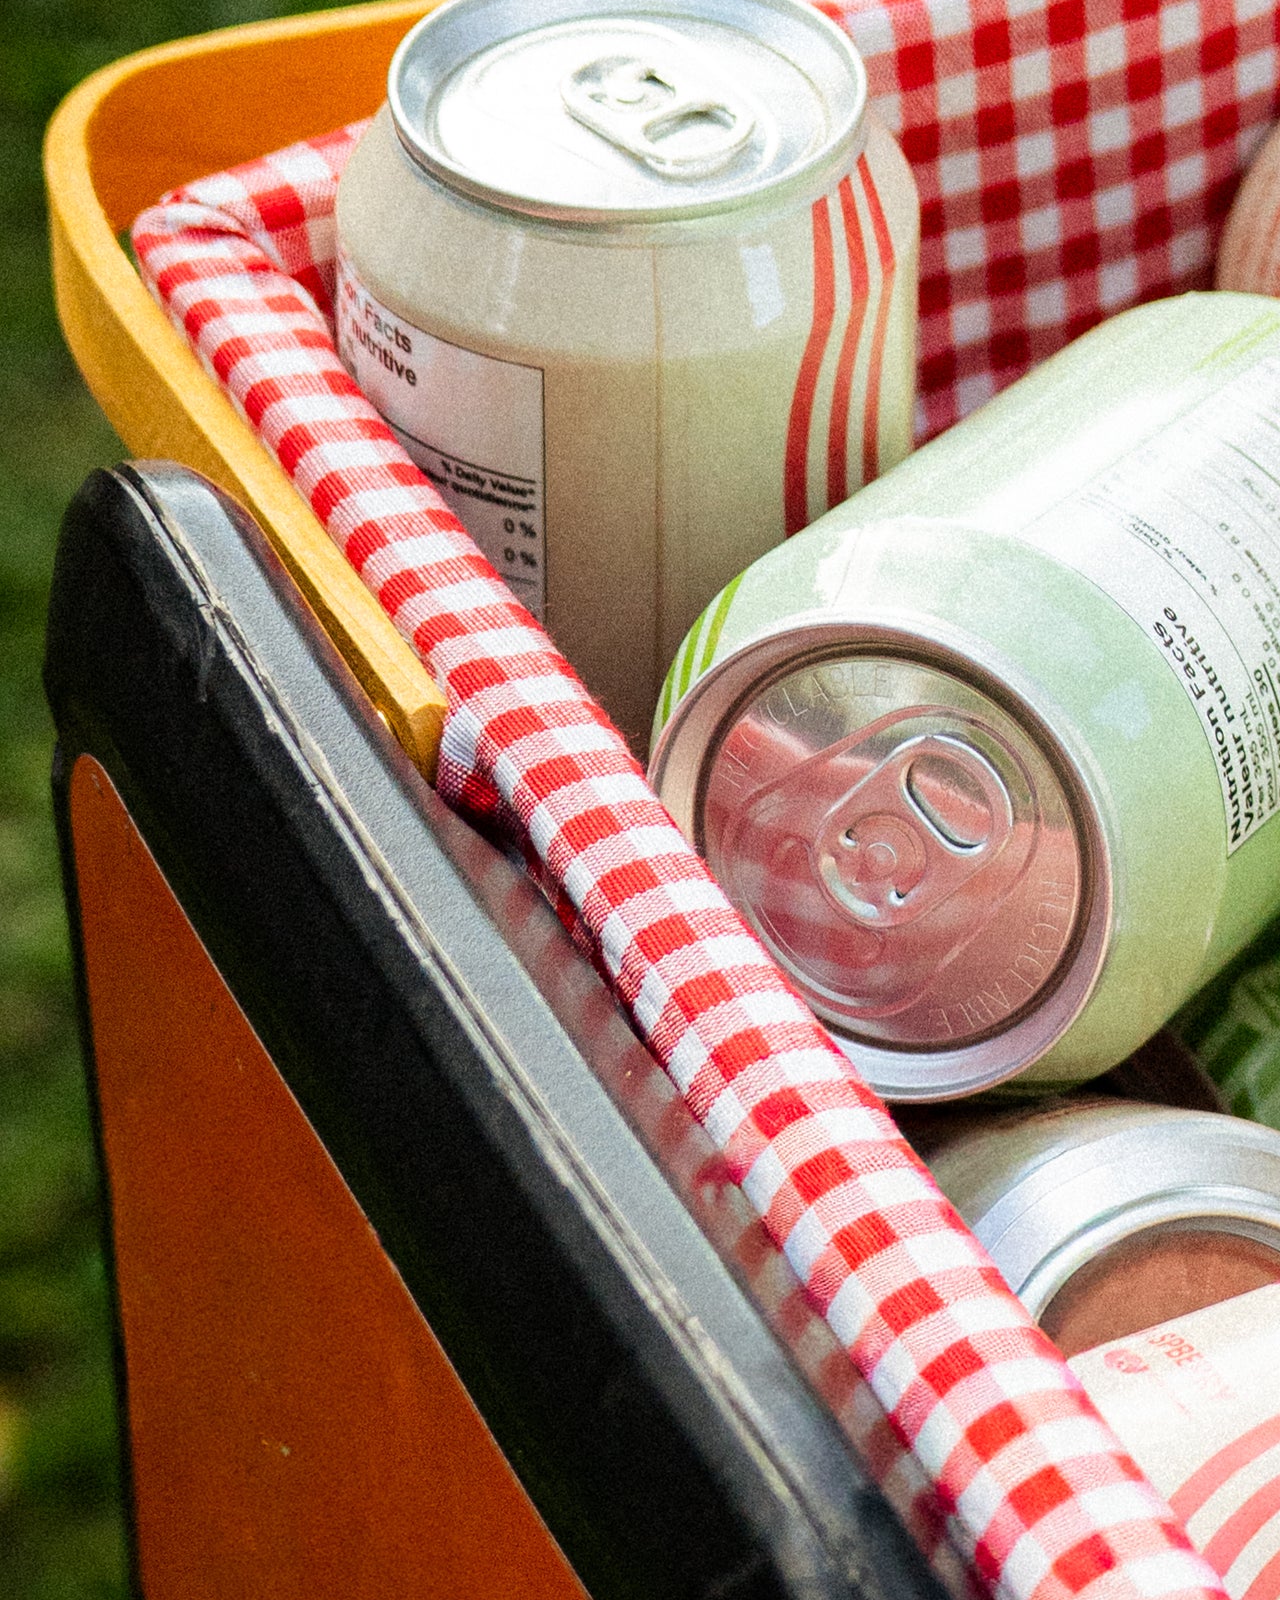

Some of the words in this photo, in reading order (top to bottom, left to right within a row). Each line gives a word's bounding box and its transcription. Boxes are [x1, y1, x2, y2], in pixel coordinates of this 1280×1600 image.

[351, 316, 417, 386] nutritive
[364, 301, 412, 353] Facts
[504, 517, 515, 535] 0
[504, 547, 515, 563] 0
[1154, 620, 1206, 701] Facts
[1161, 605, 1235, 728] nutritive
[1251, 665, 1269, 698] 30
[1203, 702, 1241, 845] Nutrition
[1229, 726, 1254, 833] Valeur
